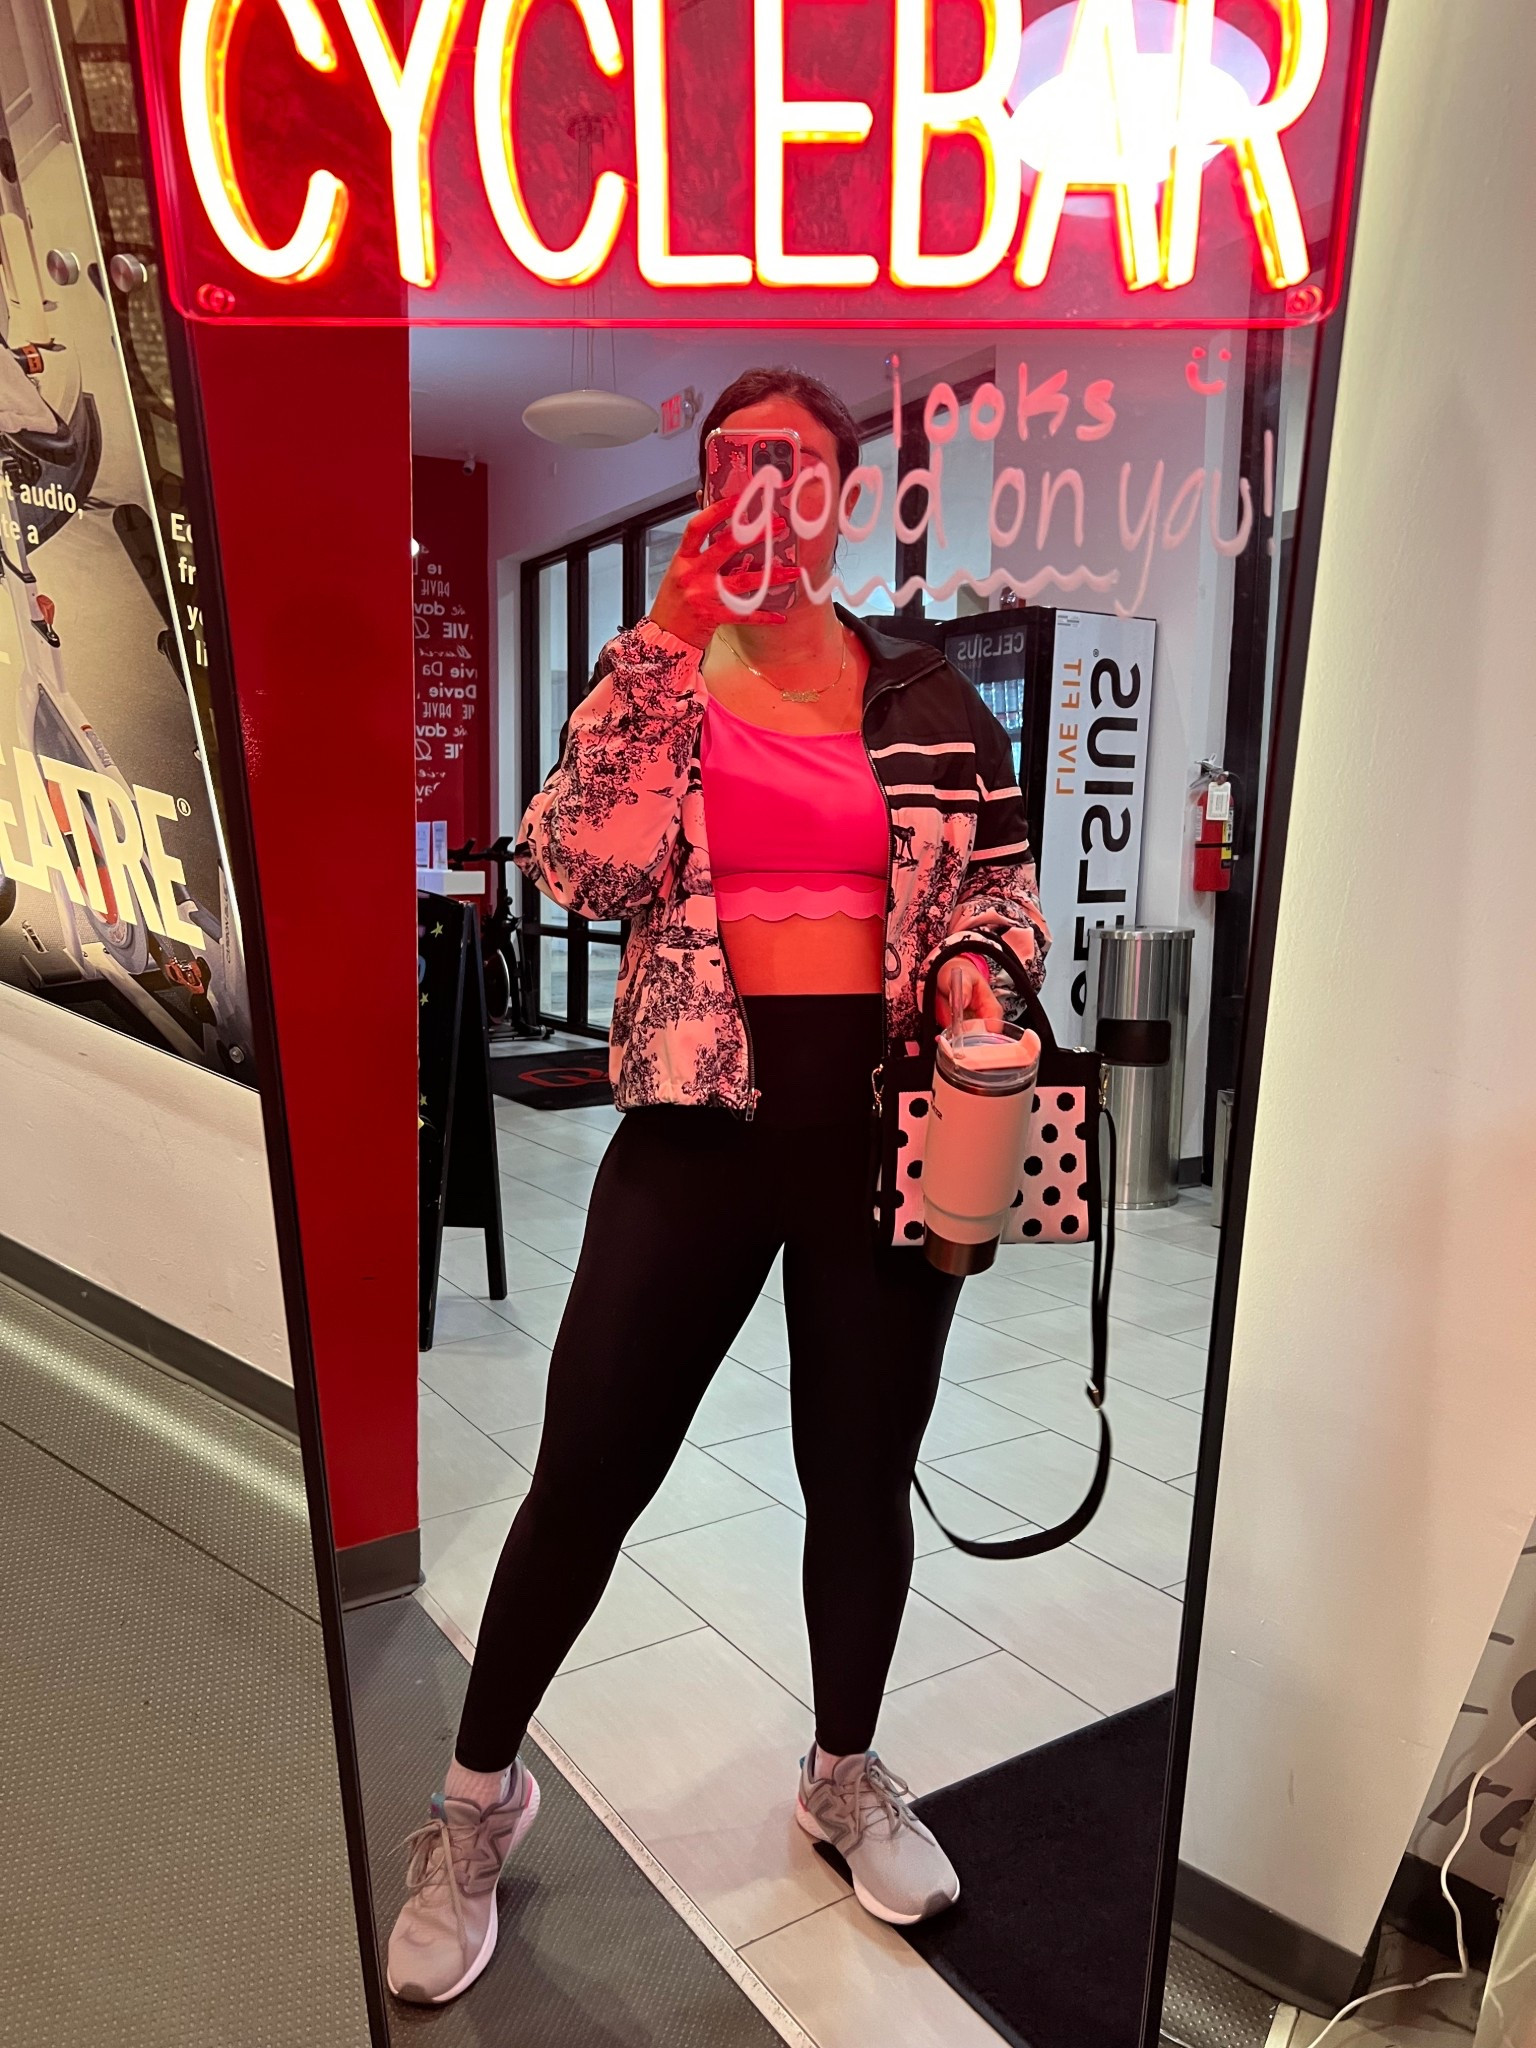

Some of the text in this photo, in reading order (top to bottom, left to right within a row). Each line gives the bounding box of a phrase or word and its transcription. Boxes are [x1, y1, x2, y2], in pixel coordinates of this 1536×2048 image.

[178, 0, 1329, 290] CYCLEBAR
[891, 352, 1118, 450] looks
[20, 483, 83, 520] audio,
[27, 524, 40, 545] a
[714, 448, 947, 616] good
[988, 466, 1086, 551] on
